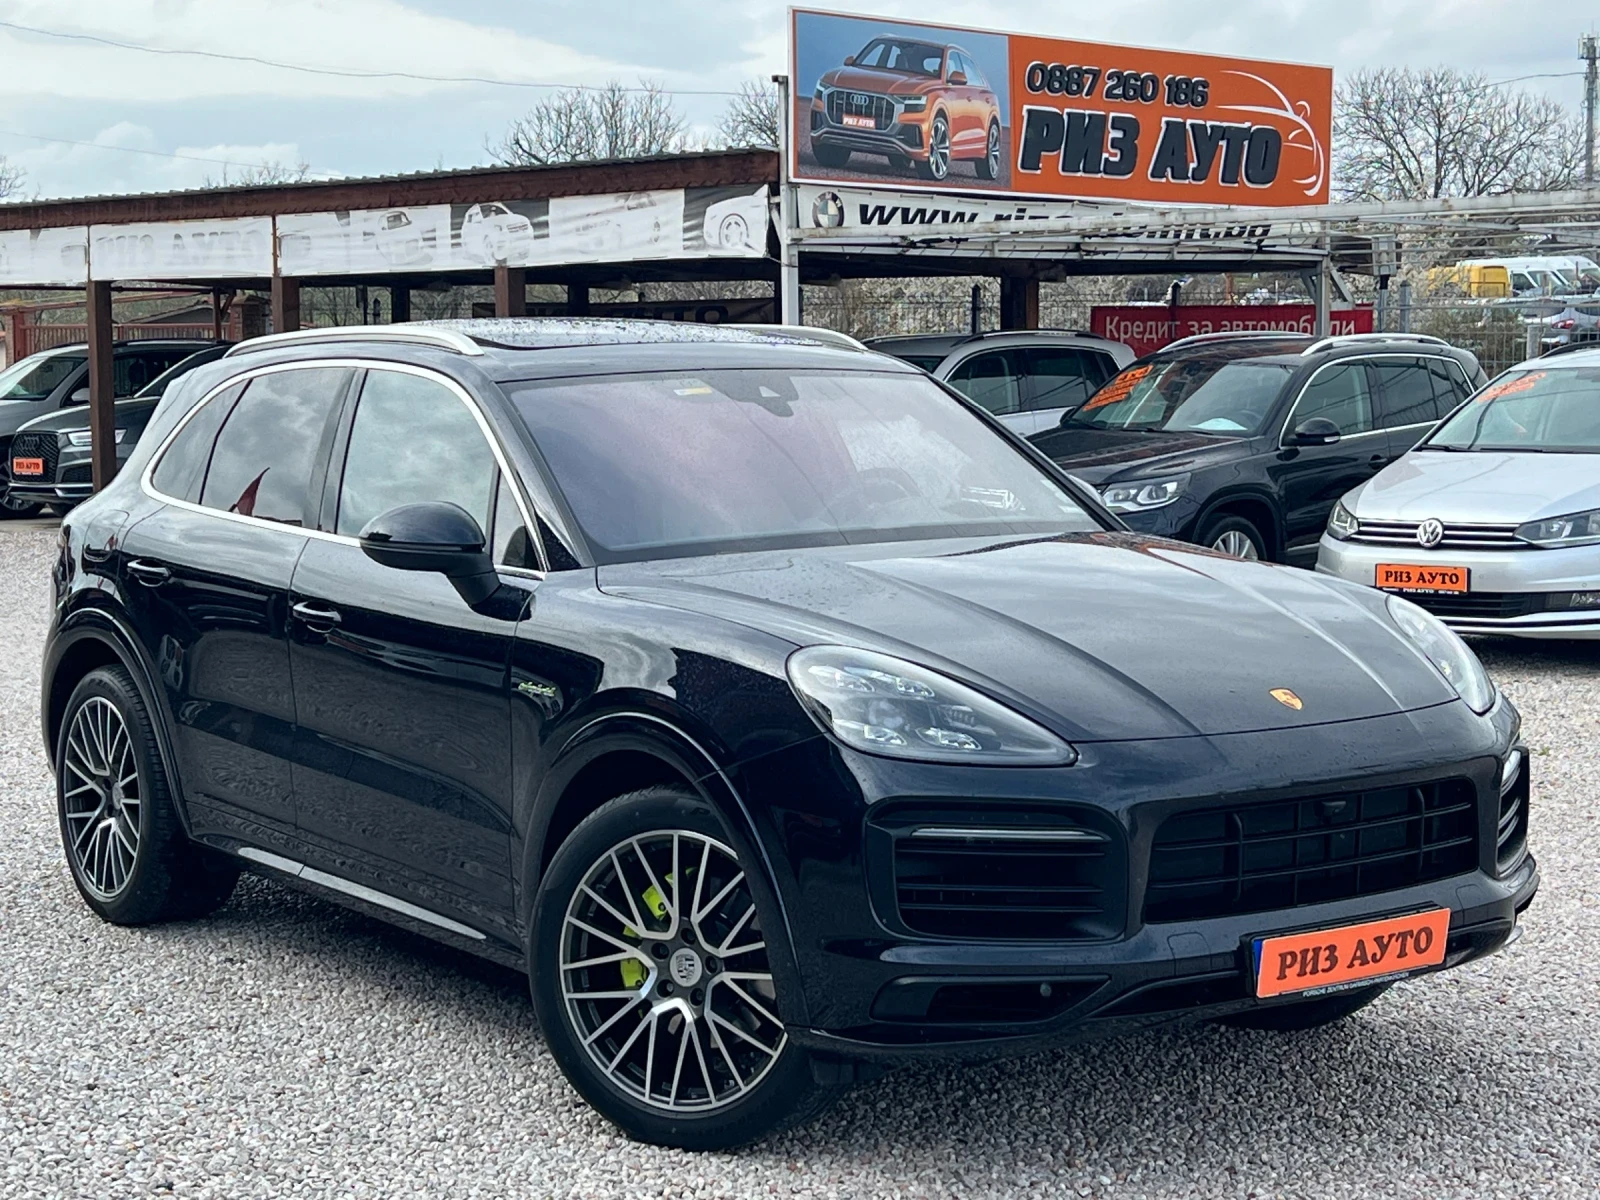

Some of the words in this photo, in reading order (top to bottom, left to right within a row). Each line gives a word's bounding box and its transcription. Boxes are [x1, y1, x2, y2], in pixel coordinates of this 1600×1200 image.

[1026, 61, 1101, 97] 0887
[1104, 69, 1159, 104] 260
[1164, 74, 1209, 108] 186
[1018, 104, 1140, 178] РИЗ
[1148, 117, 1282, 188] АУТО
[1105, 315, 1180, 342] Кредит
[1188, 319, 1213, 336] за
[1220, 314, 1355, 337] автомобли
[1385, 571, 1412, 583] РИЗ
[1416, 572, 1459, 584] АУТО
[1277, 944, 1338, 980] РИЗ
[1347, 927, 1433, 968] АУТО
